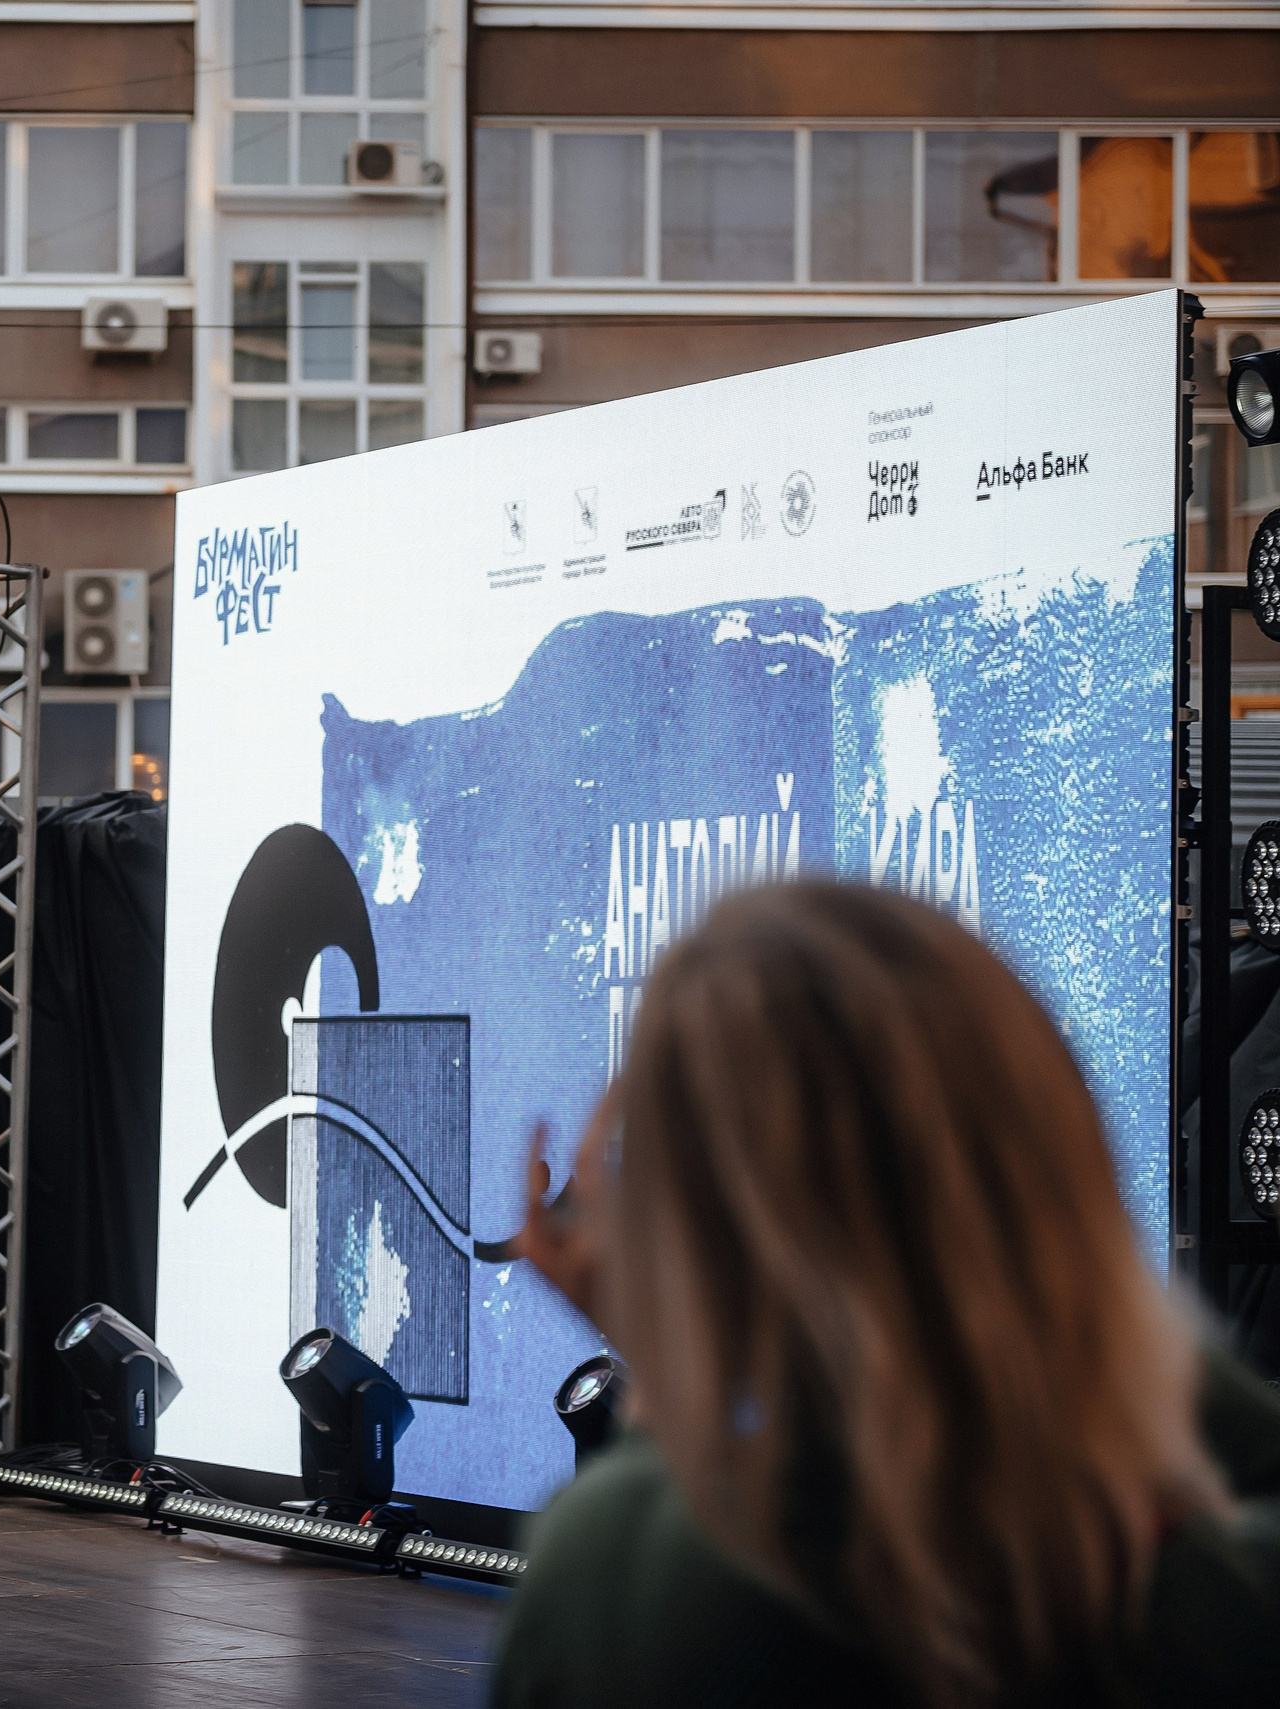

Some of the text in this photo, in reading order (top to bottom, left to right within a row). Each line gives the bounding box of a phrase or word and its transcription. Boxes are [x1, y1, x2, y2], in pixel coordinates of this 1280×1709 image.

[868, 460, 919, 493] Черри
[977, 450, 1089, 492] Альфа Банк
[625, 525, 669, 543] РУССКОГО
[671, 520, 702, 536] СЕВЕРА
[194, 520, 298, 600] БУРМАГИН
[216, 571, 282, 647] ФЕСТ
